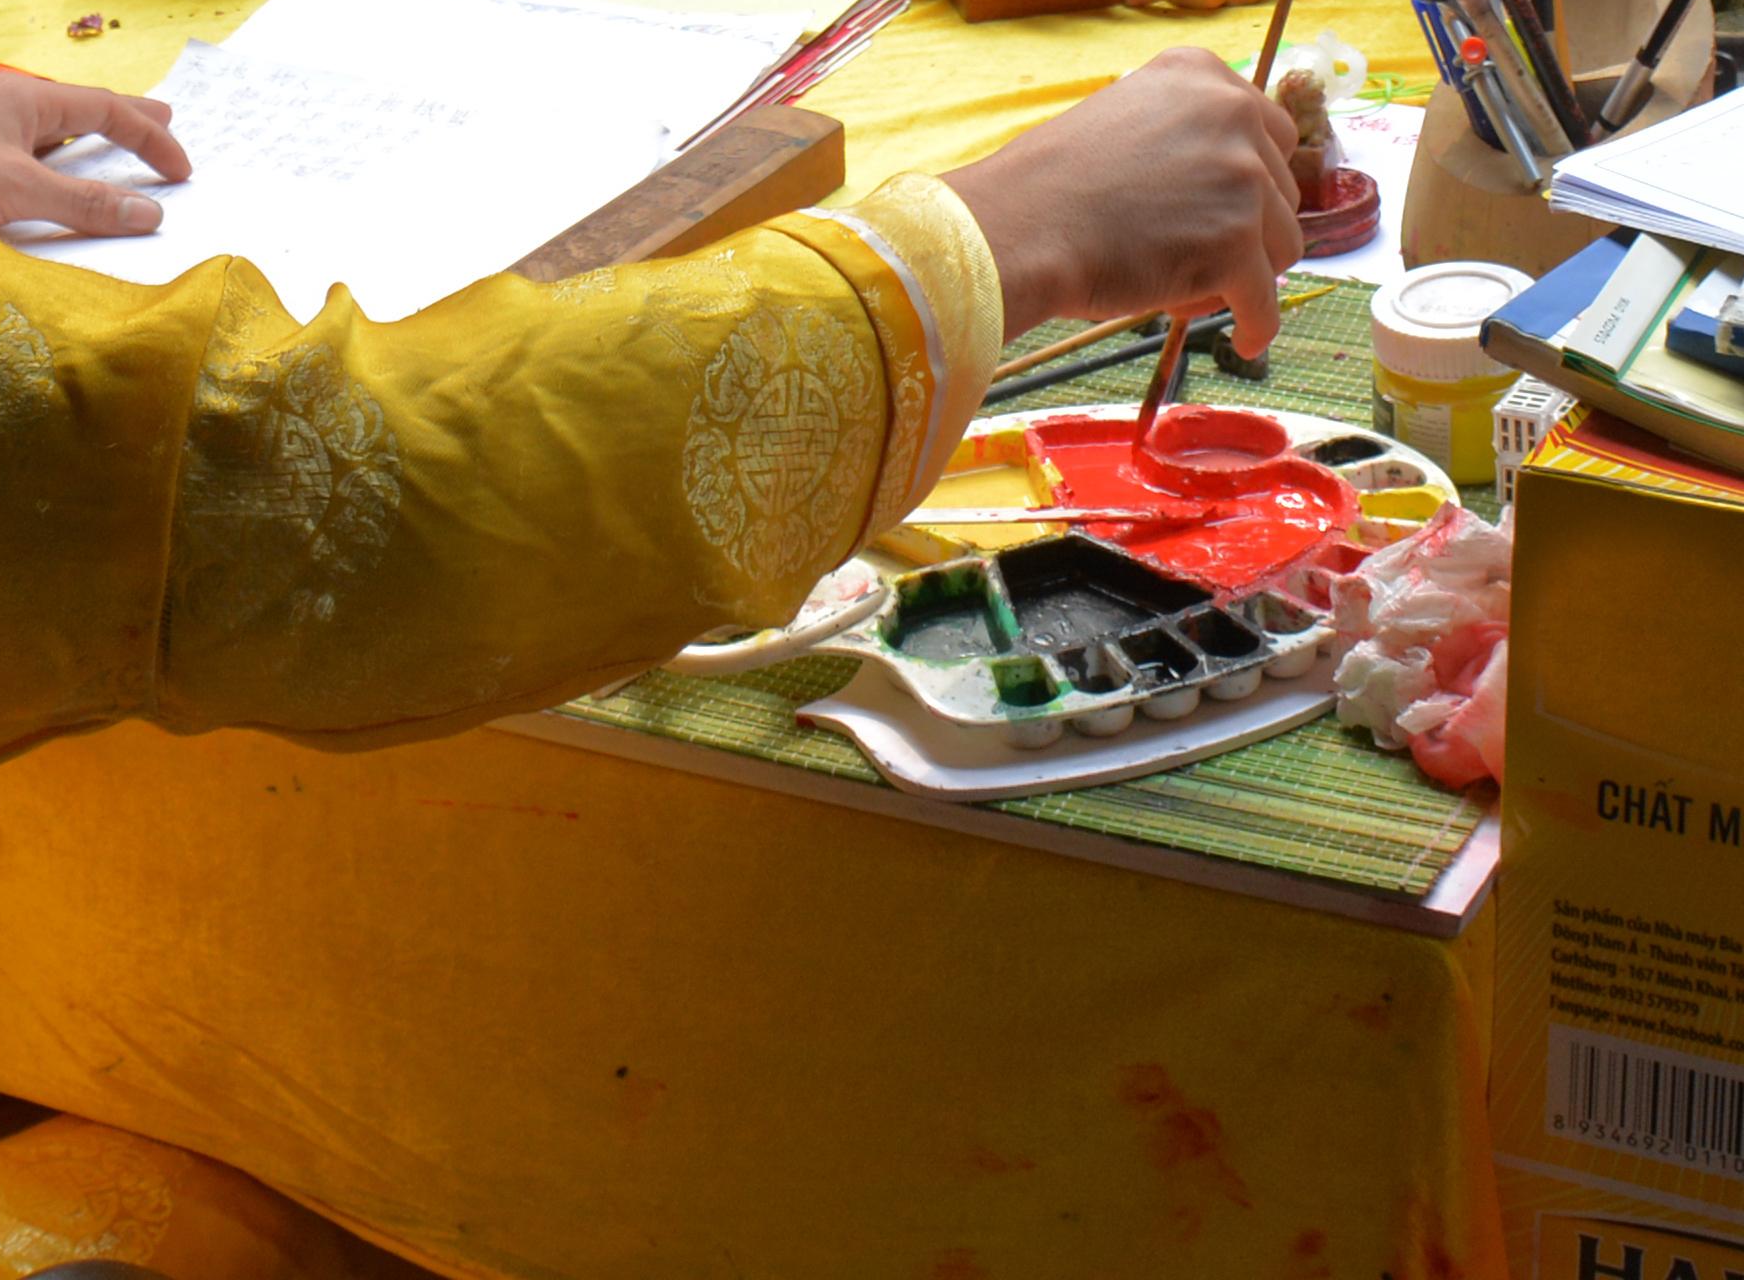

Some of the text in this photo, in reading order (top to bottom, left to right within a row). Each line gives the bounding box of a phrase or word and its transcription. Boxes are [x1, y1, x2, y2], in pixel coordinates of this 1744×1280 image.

[1596, 777, 1694, 835] CHẤT
[1552, 899, 1744, 953] Sản phẩm của Nhà máy Bia
[1593, 933, 1626, 952] Nam
[1627, 937, 1640, 956] Á
[1649, 944, 1694, 968] Thành
[1550, 972, 1700, 1017] Hotline: 0932 579579
[1551, 948, 1618, 978] Carlsberg
[1628, 965, 1655, 983] 167
[1656, 972, 1693, 992] Minh
[1696, 981, 1732, 1002] Khai,
[1549, 995, 1614, 1023] Fanpage:
[1552, 1113, 1566, 1131] 8
[1577, 1119, 1672, 1156] 934692
